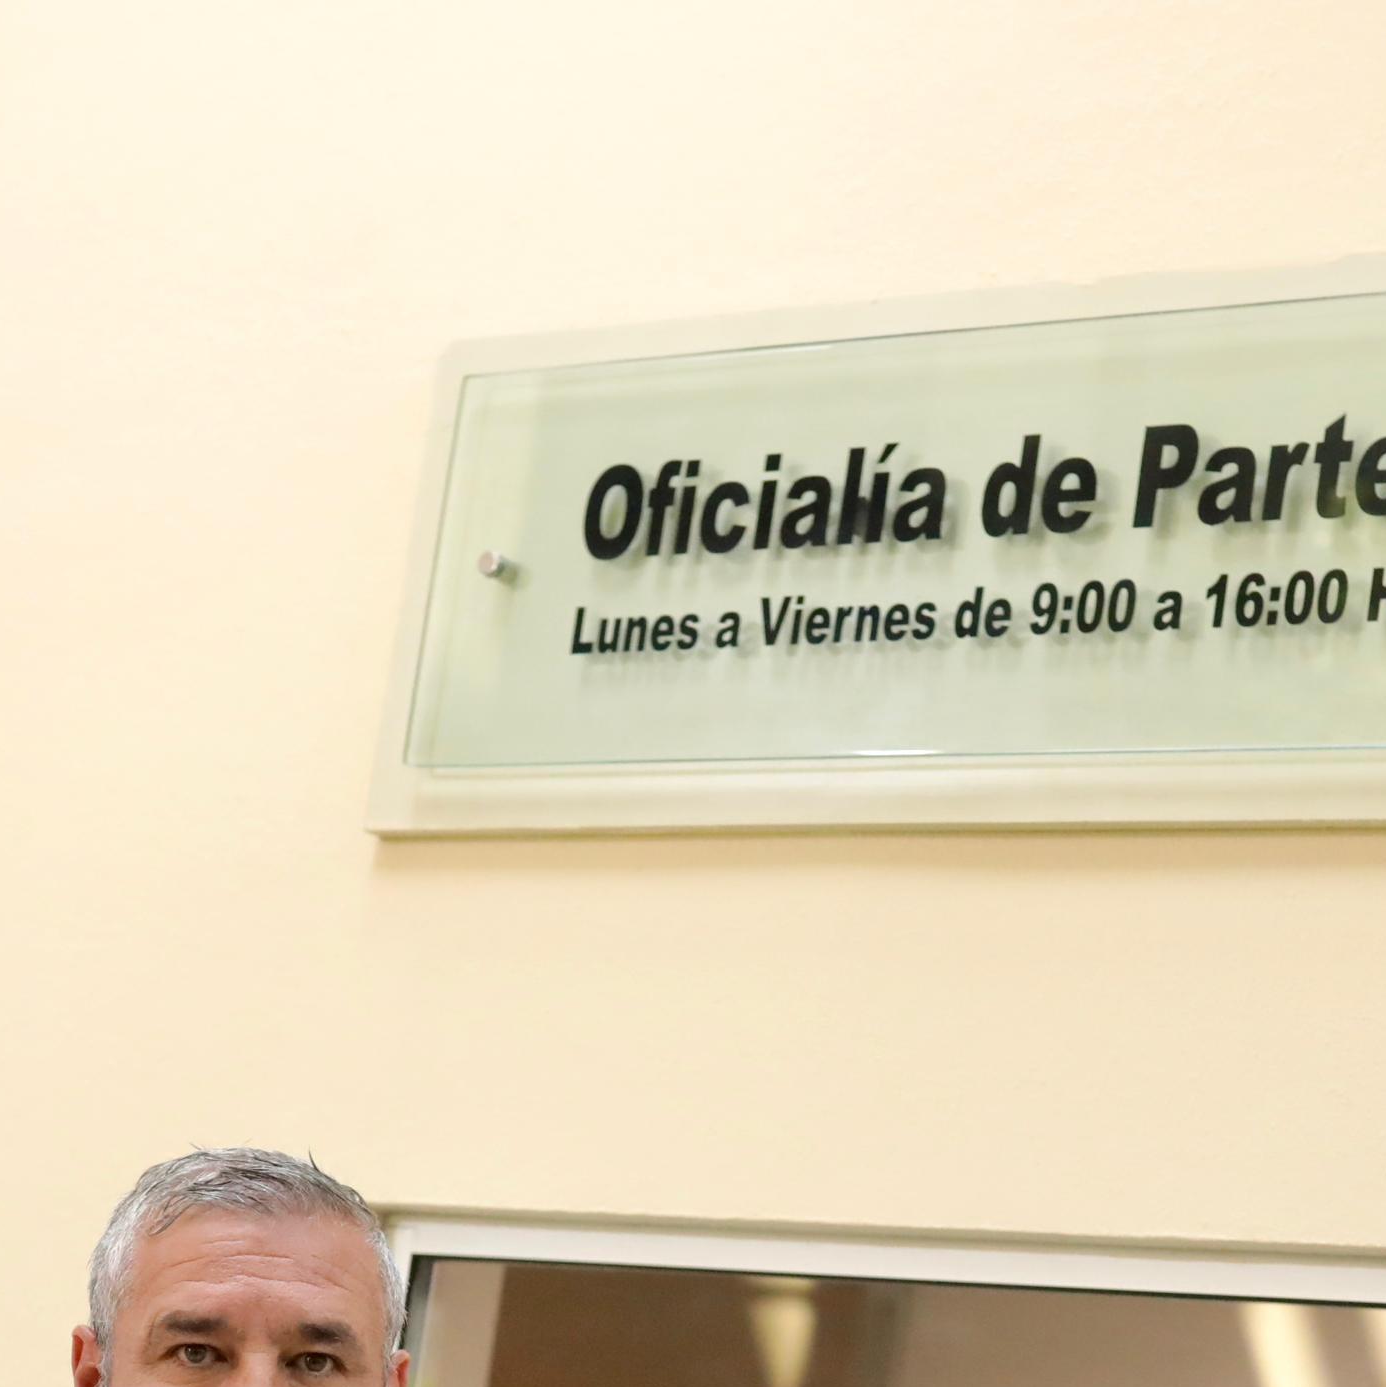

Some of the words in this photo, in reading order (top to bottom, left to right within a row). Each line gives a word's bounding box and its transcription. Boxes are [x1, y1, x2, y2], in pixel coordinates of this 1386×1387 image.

[584, 443, 946, 560] Oficialía
[982, 434, 1098, 536] de
[571, 607, 699, 655] Lunes
[716, 611, 740, 648] a
[761, 595, 936, 647] Viernes
[955, 587, 1011, 638] de
[1029, 579, 1137, 635] 9:00
[1154, 590, 1182, 630] a
[1205, 569, 1349, 628] 16:00
